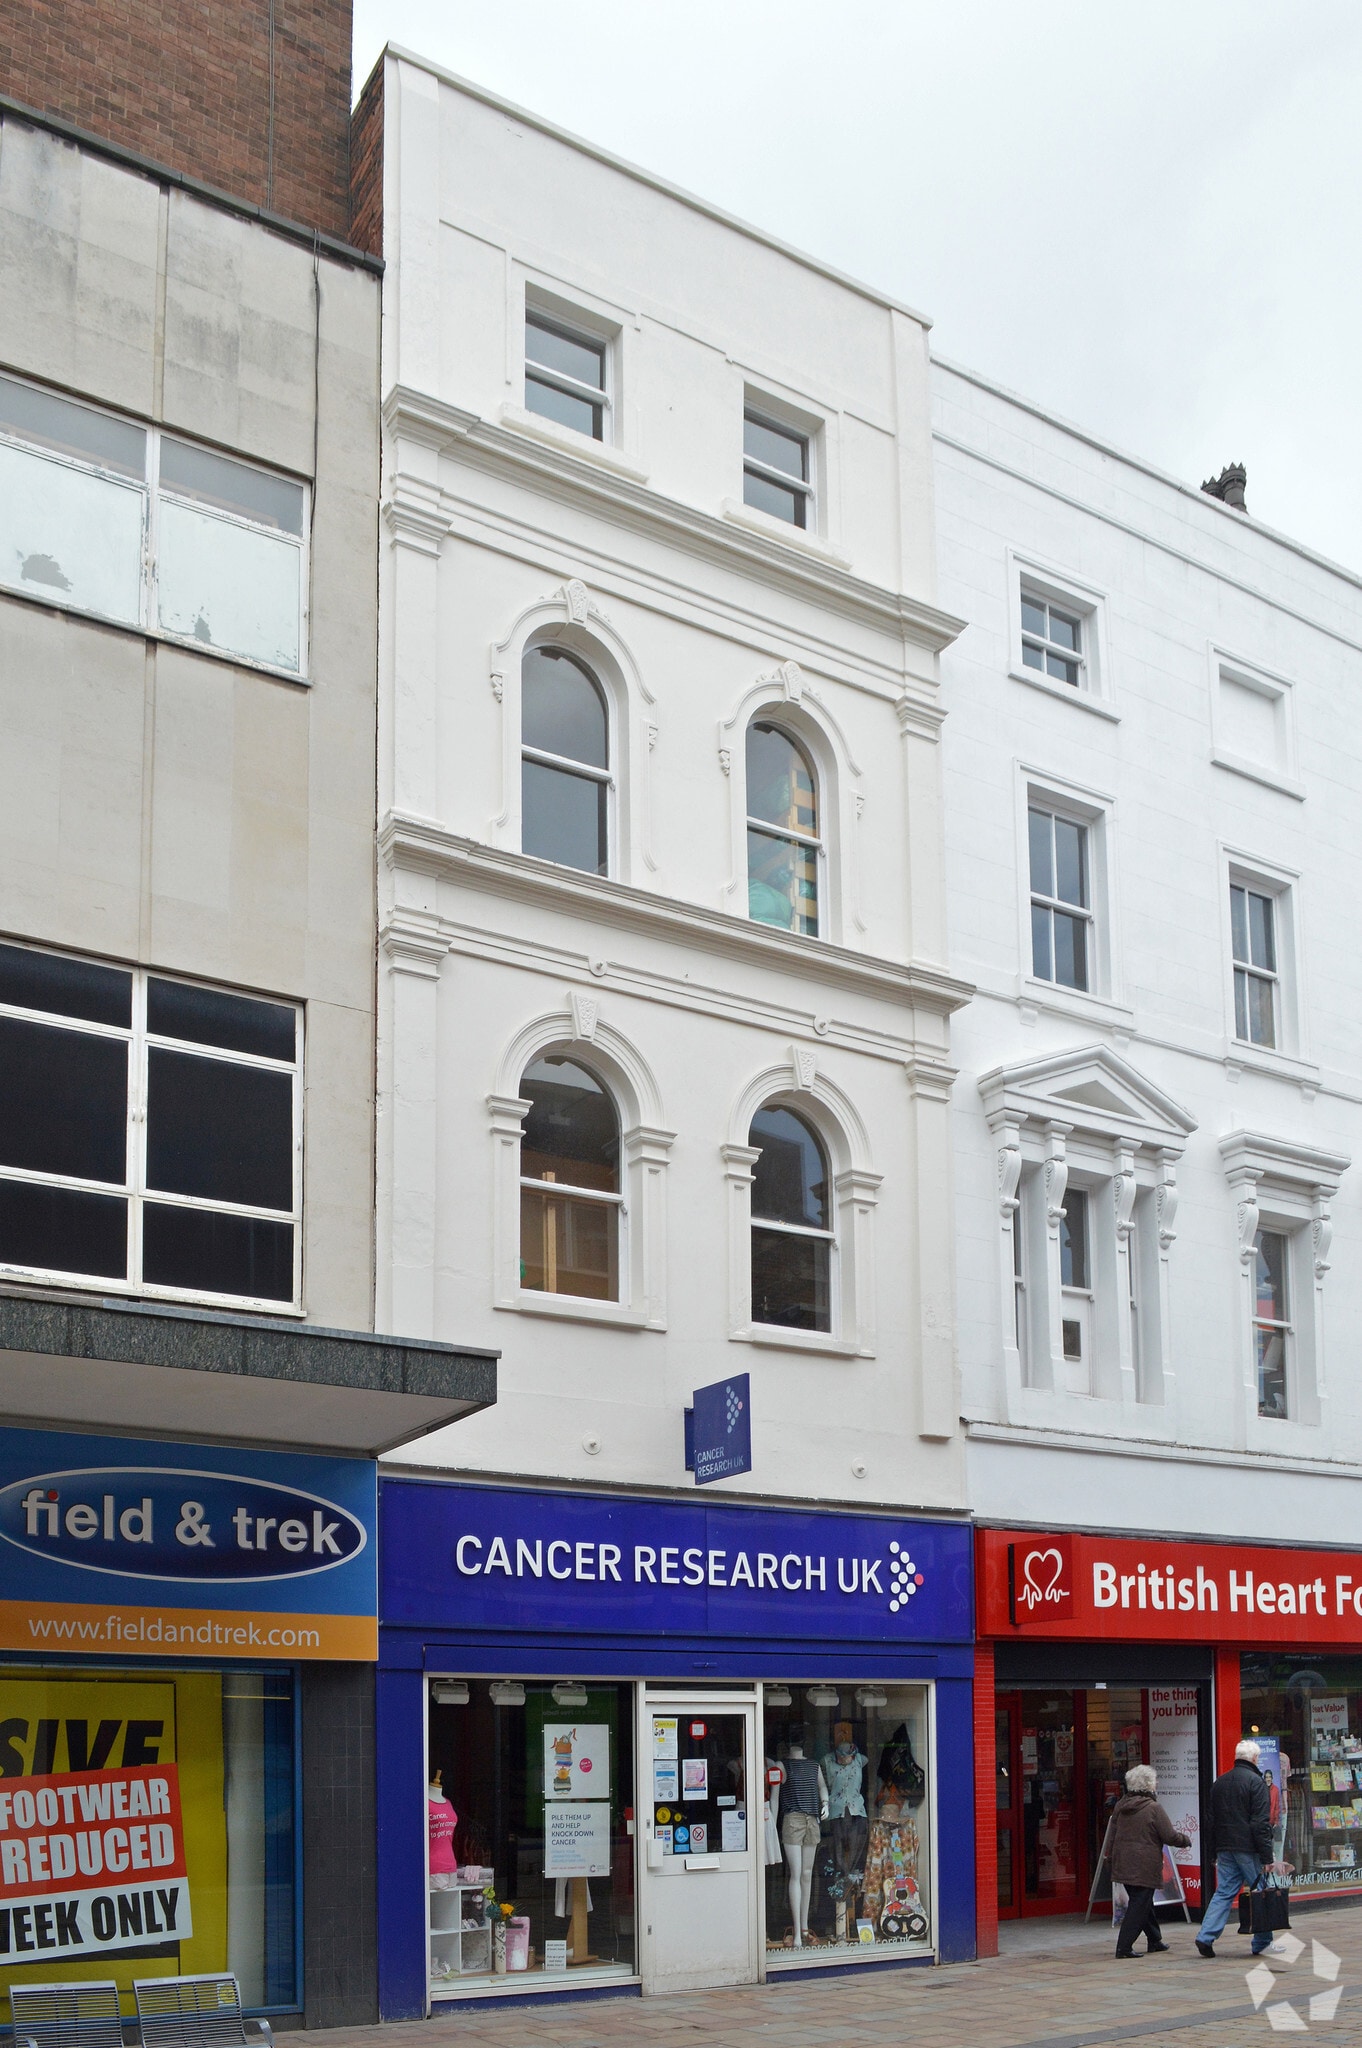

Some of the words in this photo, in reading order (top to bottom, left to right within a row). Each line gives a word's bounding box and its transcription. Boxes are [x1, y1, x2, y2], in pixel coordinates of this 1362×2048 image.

[697, 1446, 725, 1464] CANCER
[697, 1459, 733, 1478] RESEARCH
[733, 1455, 744, 1467] UK
[22, 1489, 153, 1543] field
[175, 1501, 215, 1547] &
[232, 1510, 344, 1556] trek
[456, 1534, 622, 1582] CANCER
[634, 1545, 827, 1591] RESEARCH
[837, 1557, 884, 1594] UK
[1093, 1562, 1219, 1611] British
[1229, 1570, 1327, 1615] Heart
[28, 1616, 320, 1647] www.fieldandtrek.com
[1152, 1688, 1170, 1701] the
[1325, 1703, 1345, 1712] Value
[1151, 1706, 1172, 1720] you
[0, 1778, 171, 1831] FOOTWEAR
[1, 1823, 175, 1884] REDUCED
[1295, 1872, 1316, 1886] HEART
[1316, 1870, 1340, 1884] DISEASE
[91, 1887, 180, 1942] ONLY
